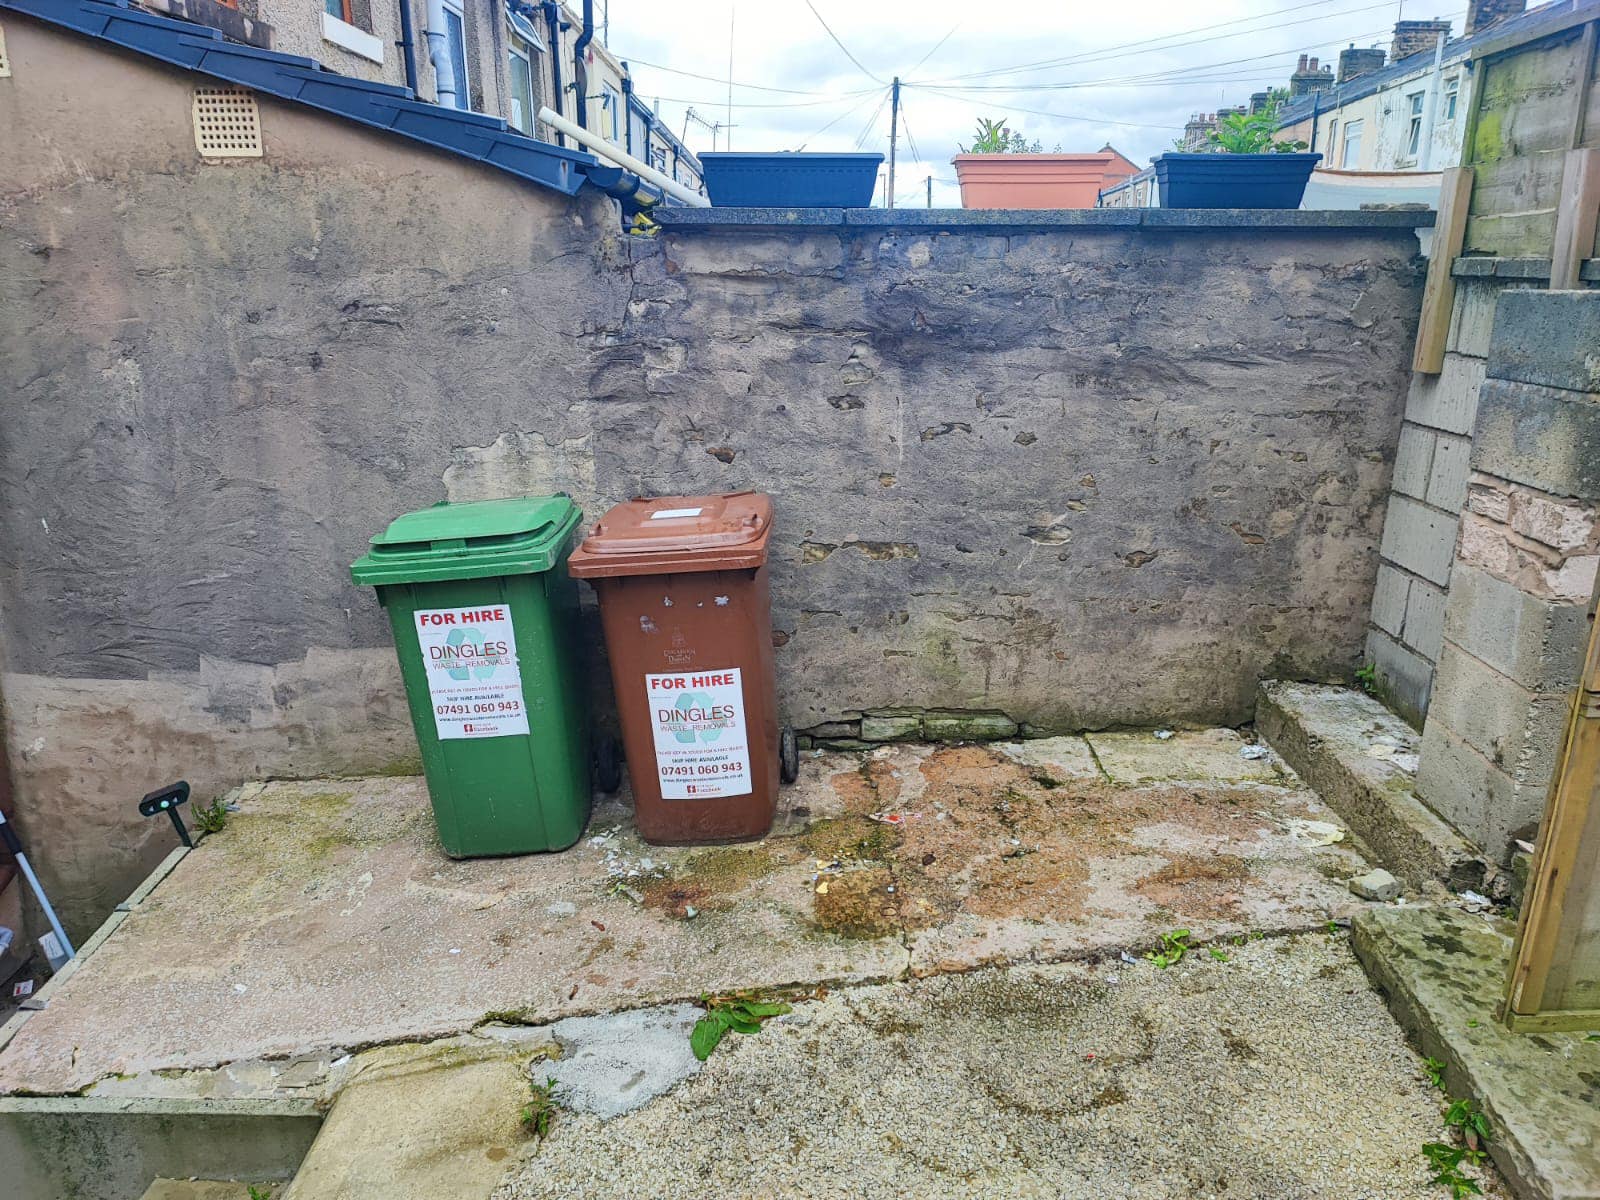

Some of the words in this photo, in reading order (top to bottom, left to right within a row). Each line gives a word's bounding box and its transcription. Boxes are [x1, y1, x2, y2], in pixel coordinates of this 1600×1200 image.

[420, 613, 456, 626] FOR
[461, 609, 505, 623] HIRE
[430, 641, 508, 660] DINGLES
[433, 661, 461, 671] WASTE
[465, 658, 511, 669] REMOVALS
[651, 678, 687, 690] FOR
[692, 673, 735, 688] HIRE
[437, 704, 471, 715] 07491
[473, 702, 495, 713] 060
[497, 700, 520, 711] 943
[658, 705, 735, 723] DINGLES
[660, 724, 688, 732] WASTE
[692, 721, 736, 731] REMOVALS
[661, 766, 694, 775] 07491
[698, 764, 719, 775] 060
[721, 762, 743, 772] 943
